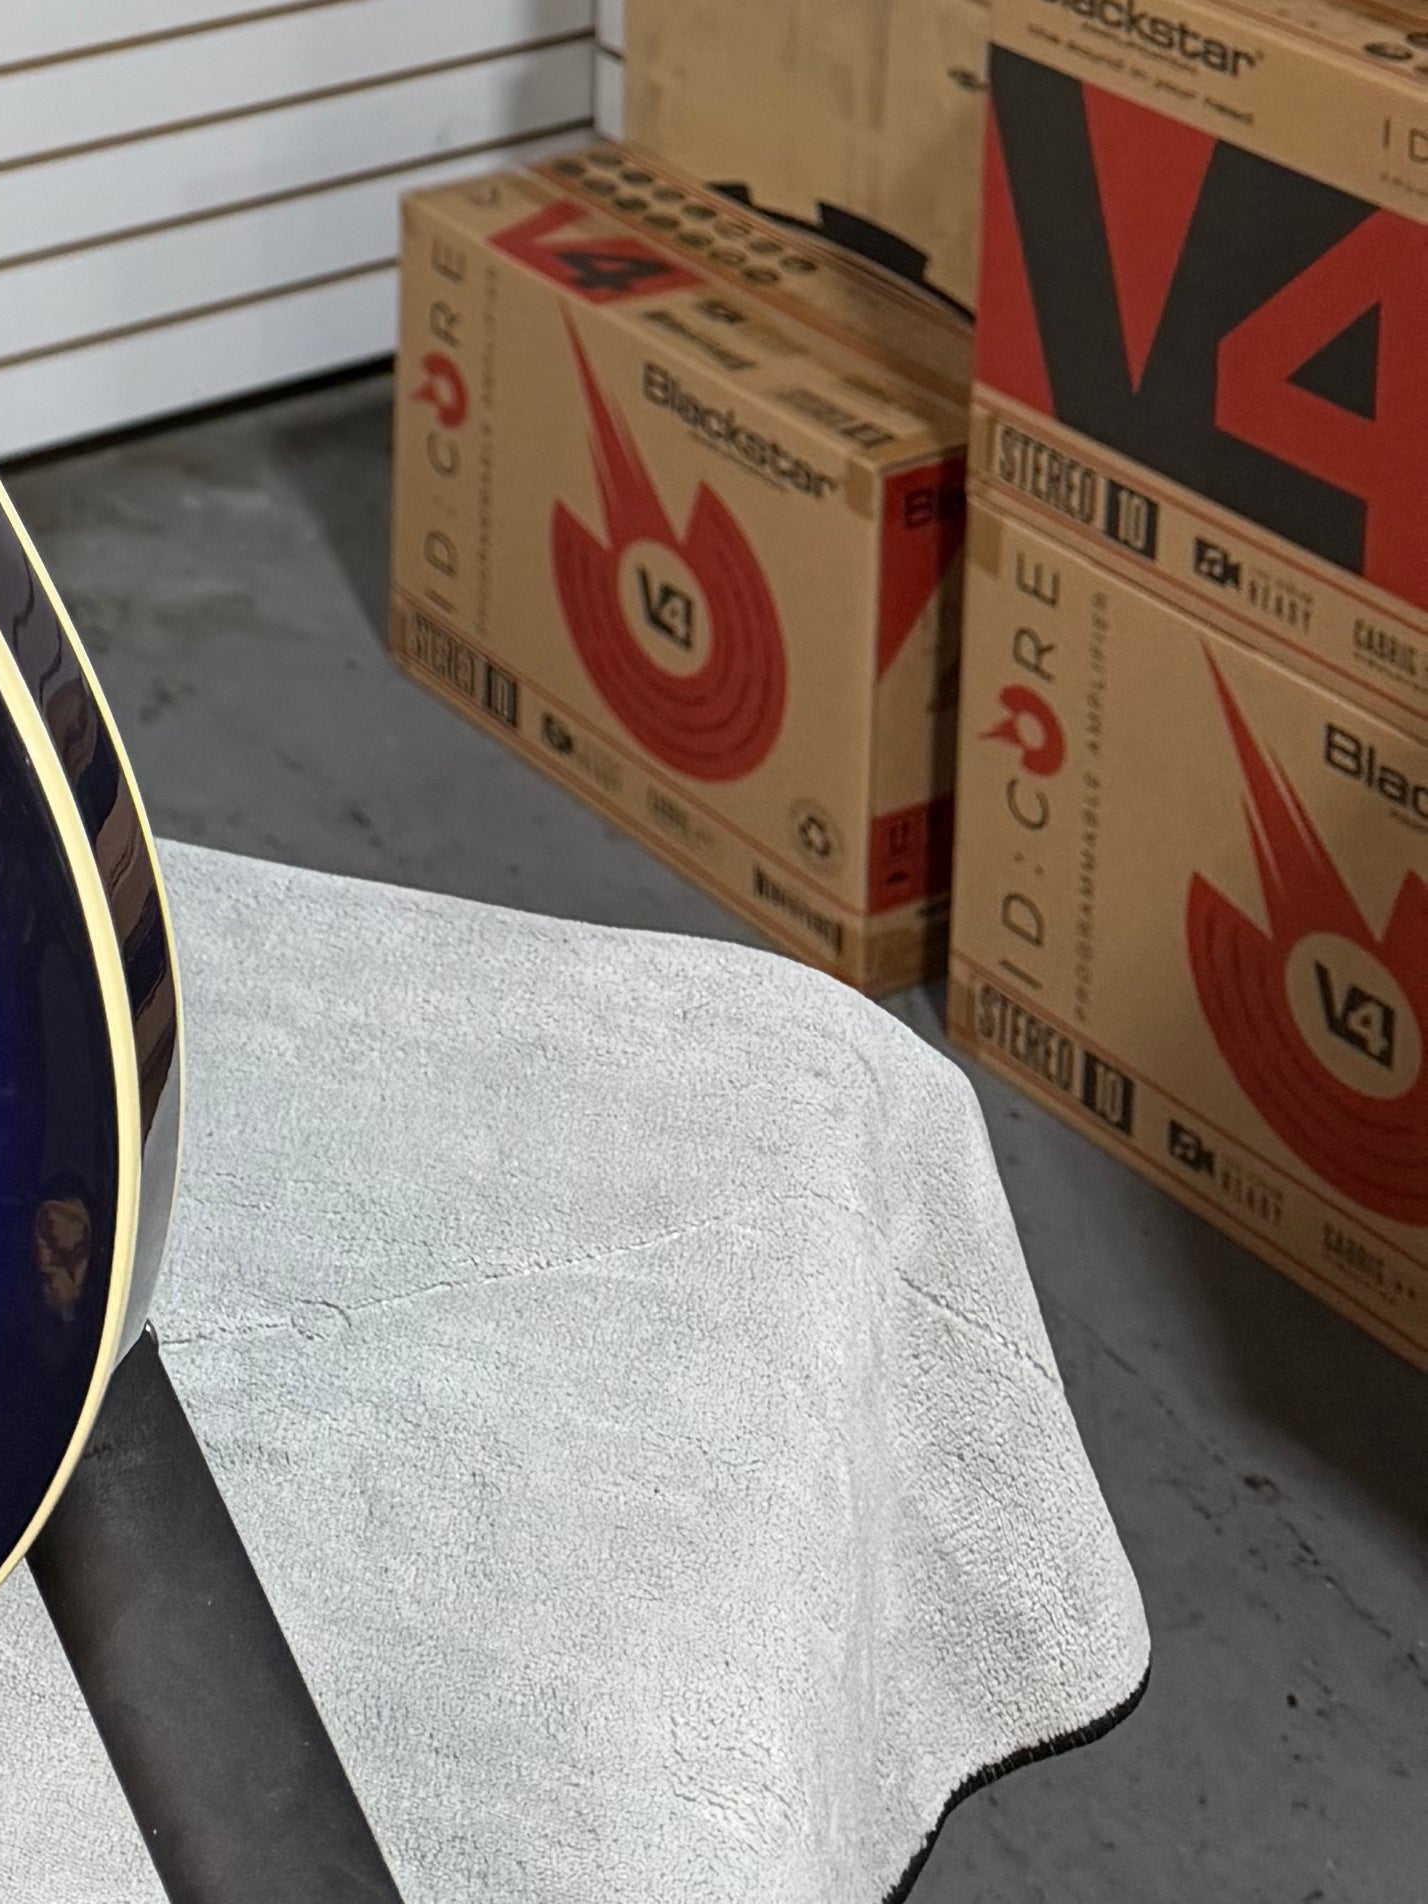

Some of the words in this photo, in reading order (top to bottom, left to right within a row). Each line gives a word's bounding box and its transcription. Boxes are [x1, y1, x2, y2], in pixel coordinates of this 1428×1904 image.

[644, 360, 838, 501] Blackstar
[997, 424, 1097, 525] STEREO
[976, 985, 1075, 1093] STEREO
[1313, 959, 1397, 1071] V4
